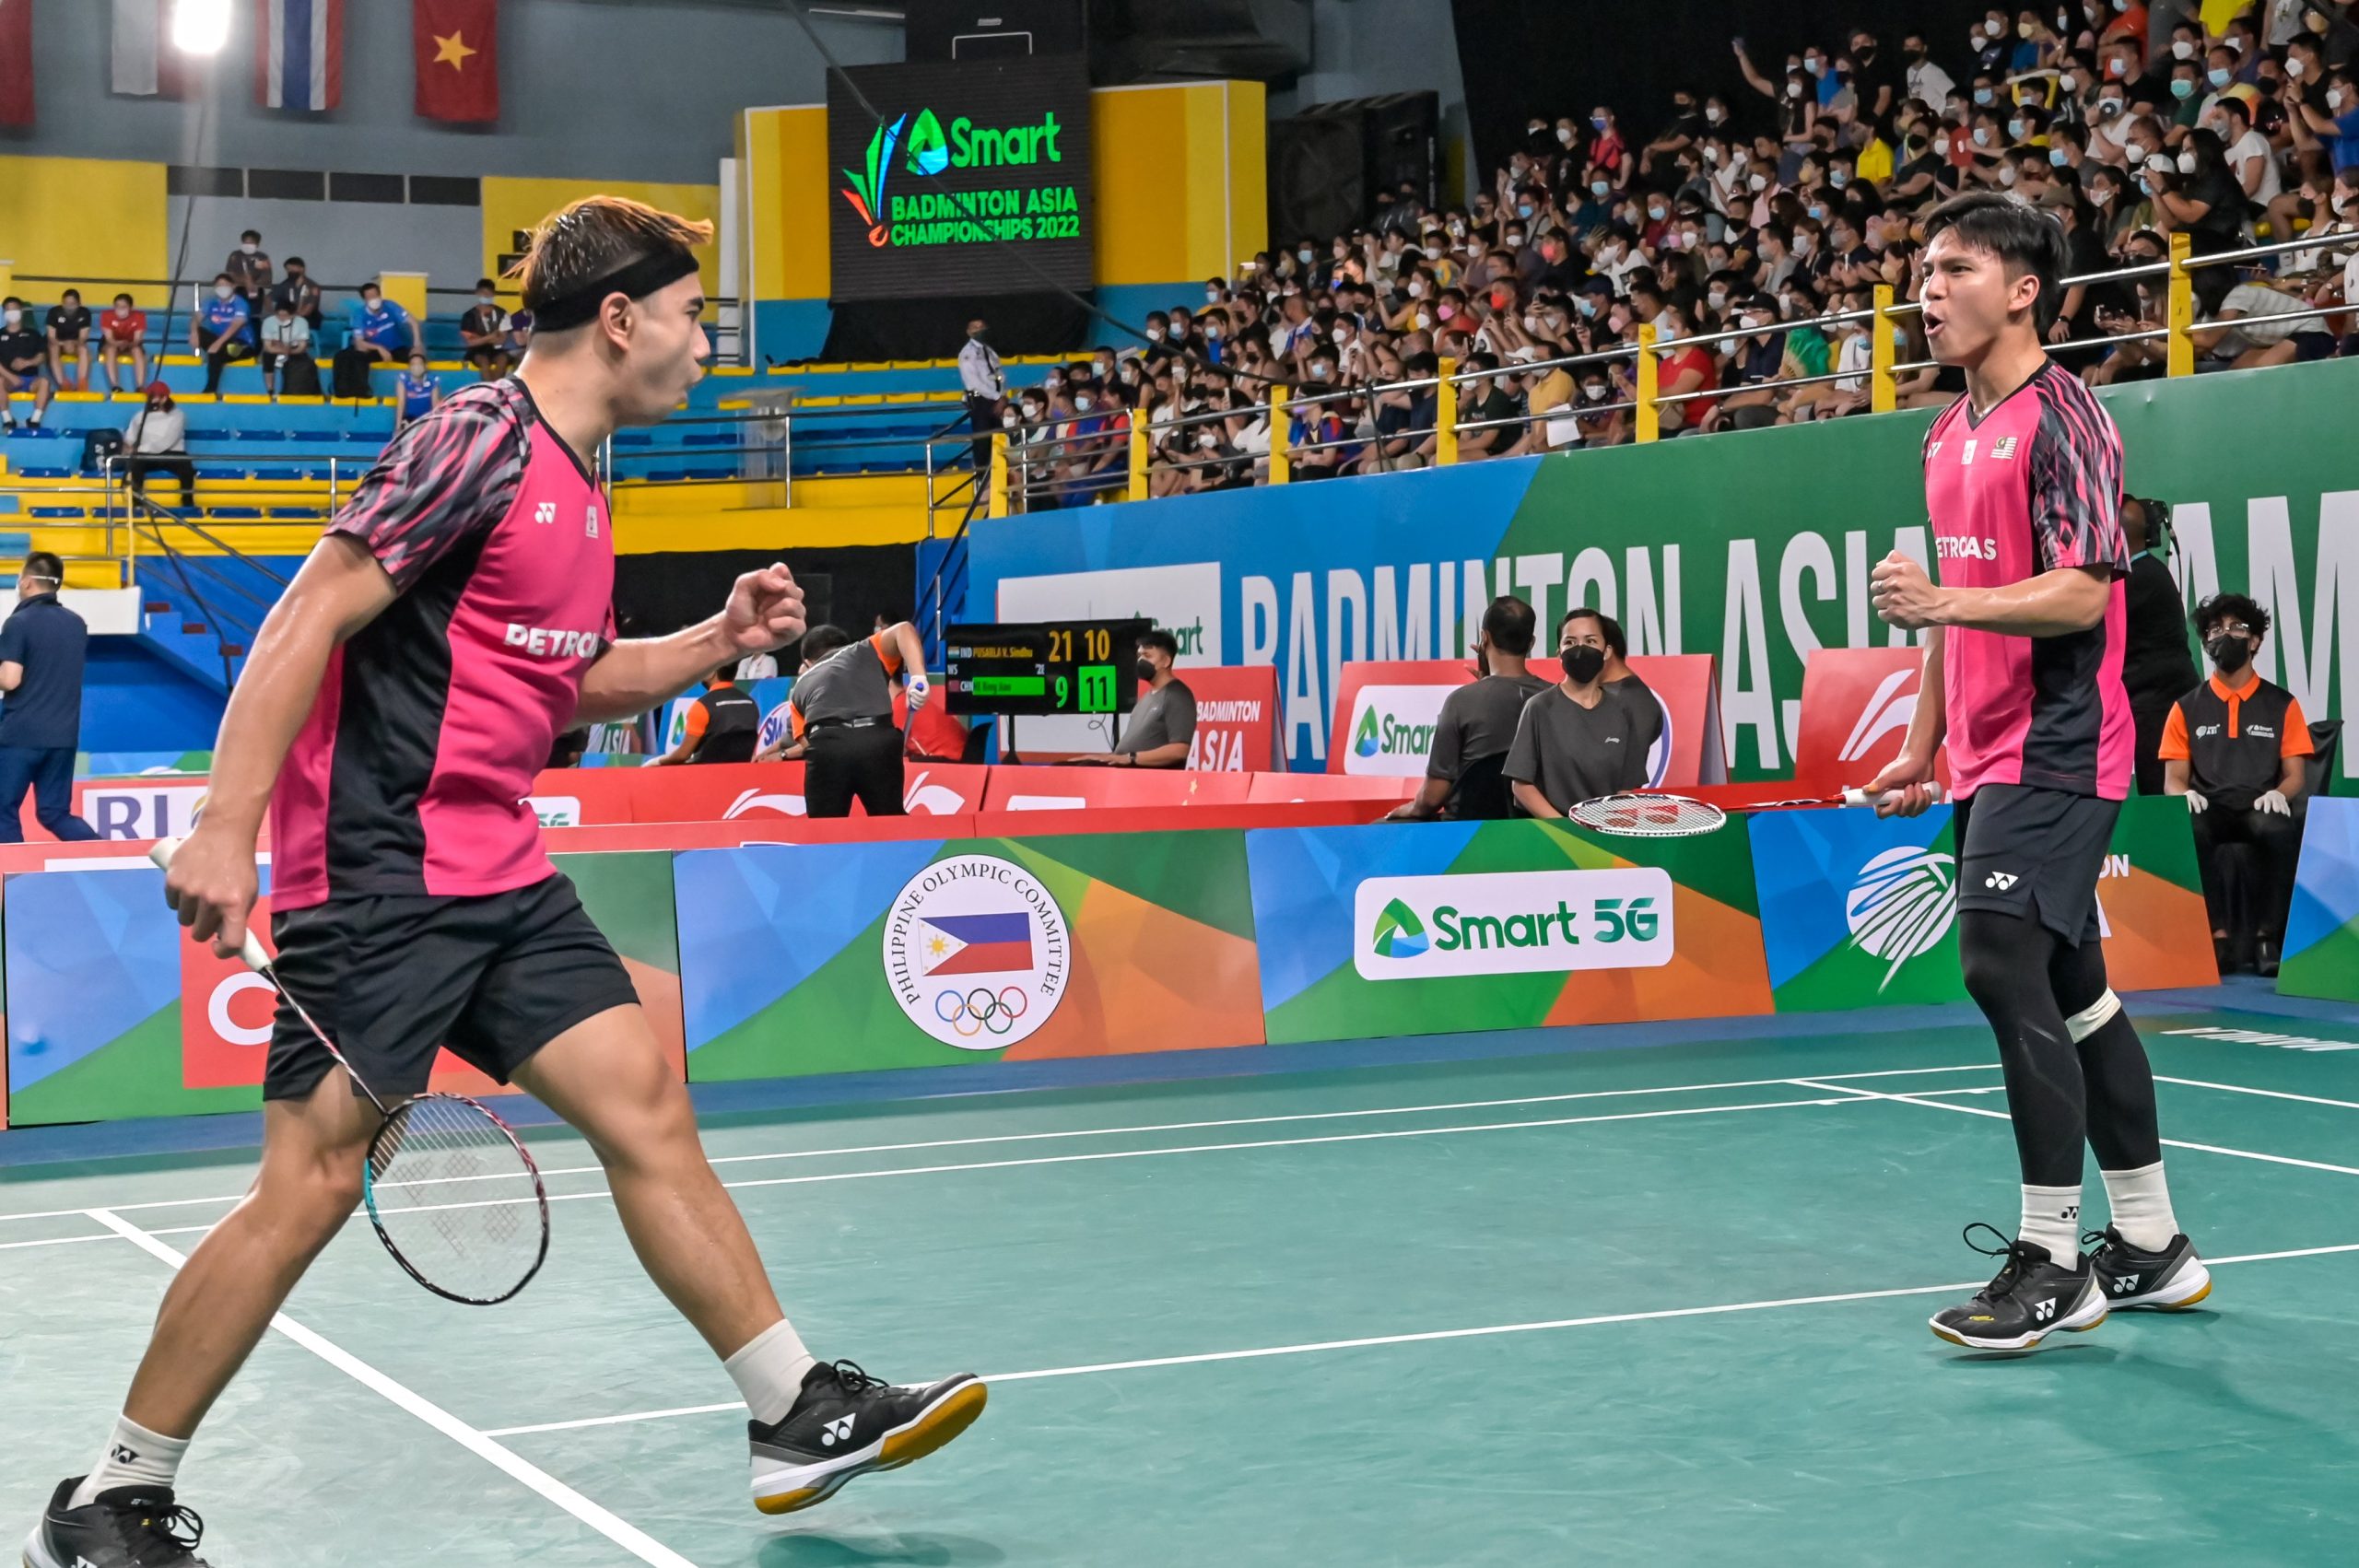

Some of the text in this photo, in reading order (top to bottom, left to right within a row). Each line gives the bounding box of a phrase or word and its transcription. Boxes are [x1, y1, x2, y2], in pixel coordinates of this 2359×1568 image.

[951, 111, 1062, 168] Smart
[891, 187, 1078, 221] BADMINTON ASIA
[891, 216, 1080, 246] CHAMPIONSHIPS 2022
[504, 623, 599, 659] PETRO
[1049, 630, 1072, 662] 21
[1085, 628, 1110, 661] 10
[1055, 676, 1069, 708] 9
[1086, 676, 1107, 708] 11
[1196, 701, 1261, 722] BADMINTON
[1185, 730, 1244, 771] ASIA
[1380, 713, 1438, 755] Smar
[891, 862, 1062, 1005] PHILIPPINE OLYMPIC COMMITTEE
[1432, 897, 1659, 951] Smart 5G
